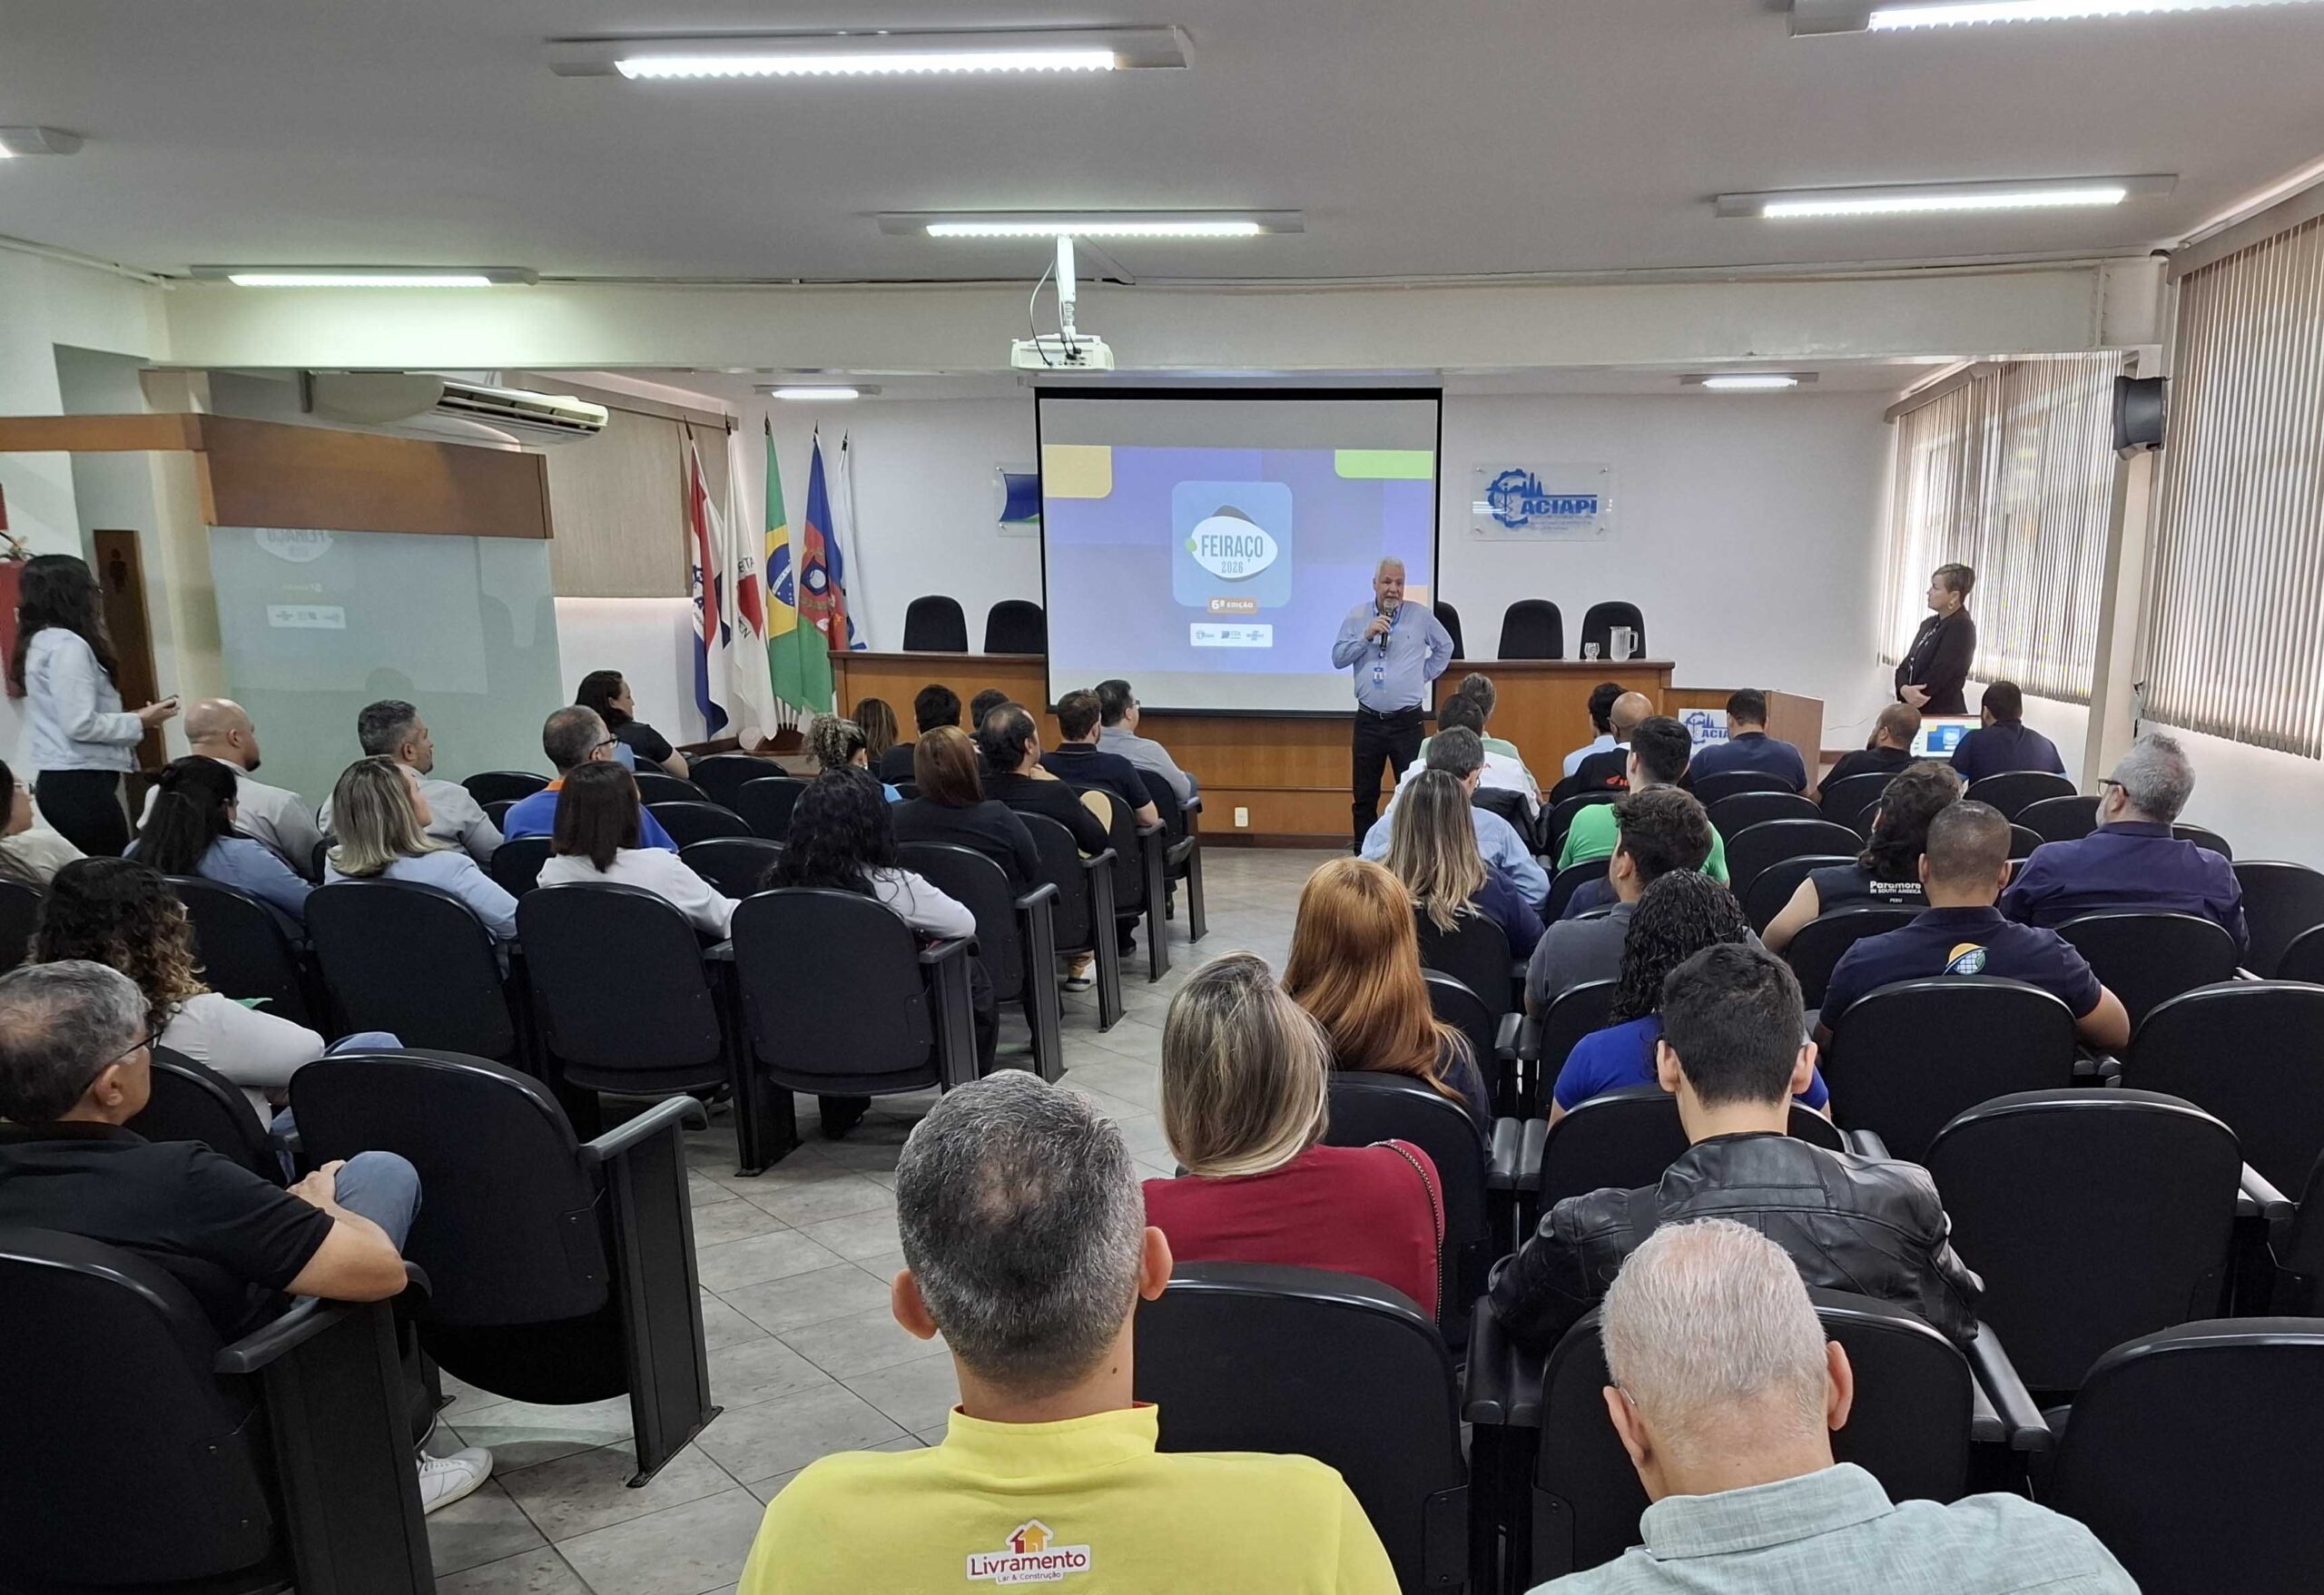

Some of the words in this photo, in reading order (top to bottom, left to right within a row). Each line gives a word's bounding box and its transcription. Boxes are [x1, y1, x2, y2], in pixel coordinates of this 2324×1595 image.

[1521, 499, 1597, 514] ACIAPI
[1201, 535, 1264, 563] FEIRAÇO
[1221, 561, 1244, 574] 2026
[1226, 601, 1254, 609] EDIÇÃO
[1701, 729, 1728, 738] ACIA
[1870, 881, 1921, 889] Paramore
[970, 1551, 1087, 1576] Livramento
[1019, 1571, 1061, 1580] Construção
